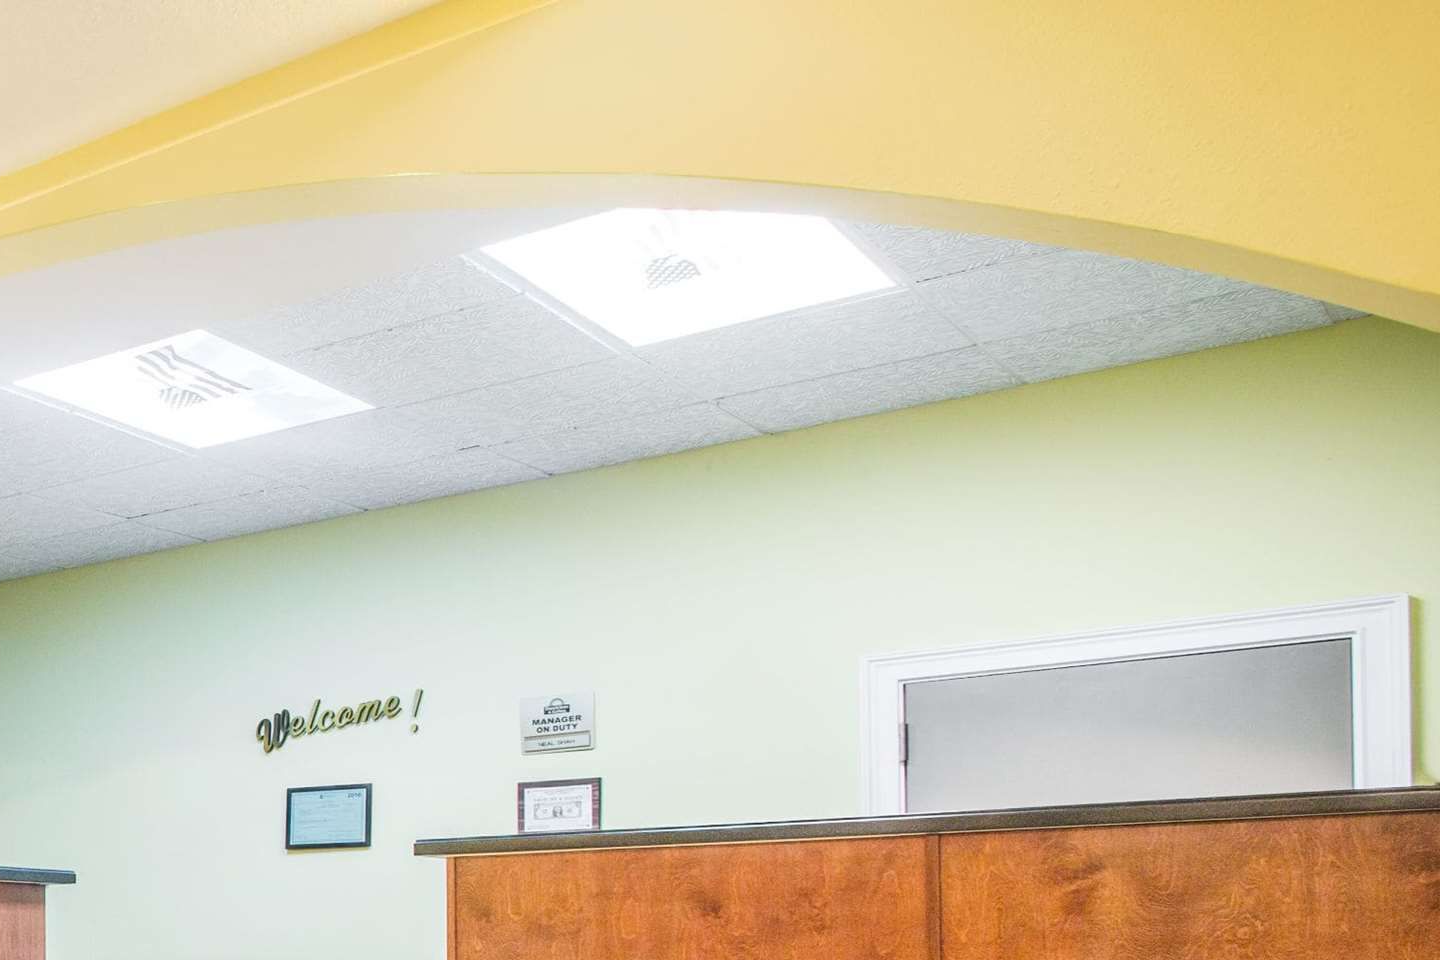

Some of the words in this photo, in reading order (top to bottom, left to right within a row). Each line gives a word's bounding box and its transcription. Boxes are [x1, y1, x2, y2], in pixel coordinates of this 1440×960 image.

[531, 714, 582, 726] MANAGER
[536, 726, 550, 734] ON
[553, 723, 578, 732] DUTY
